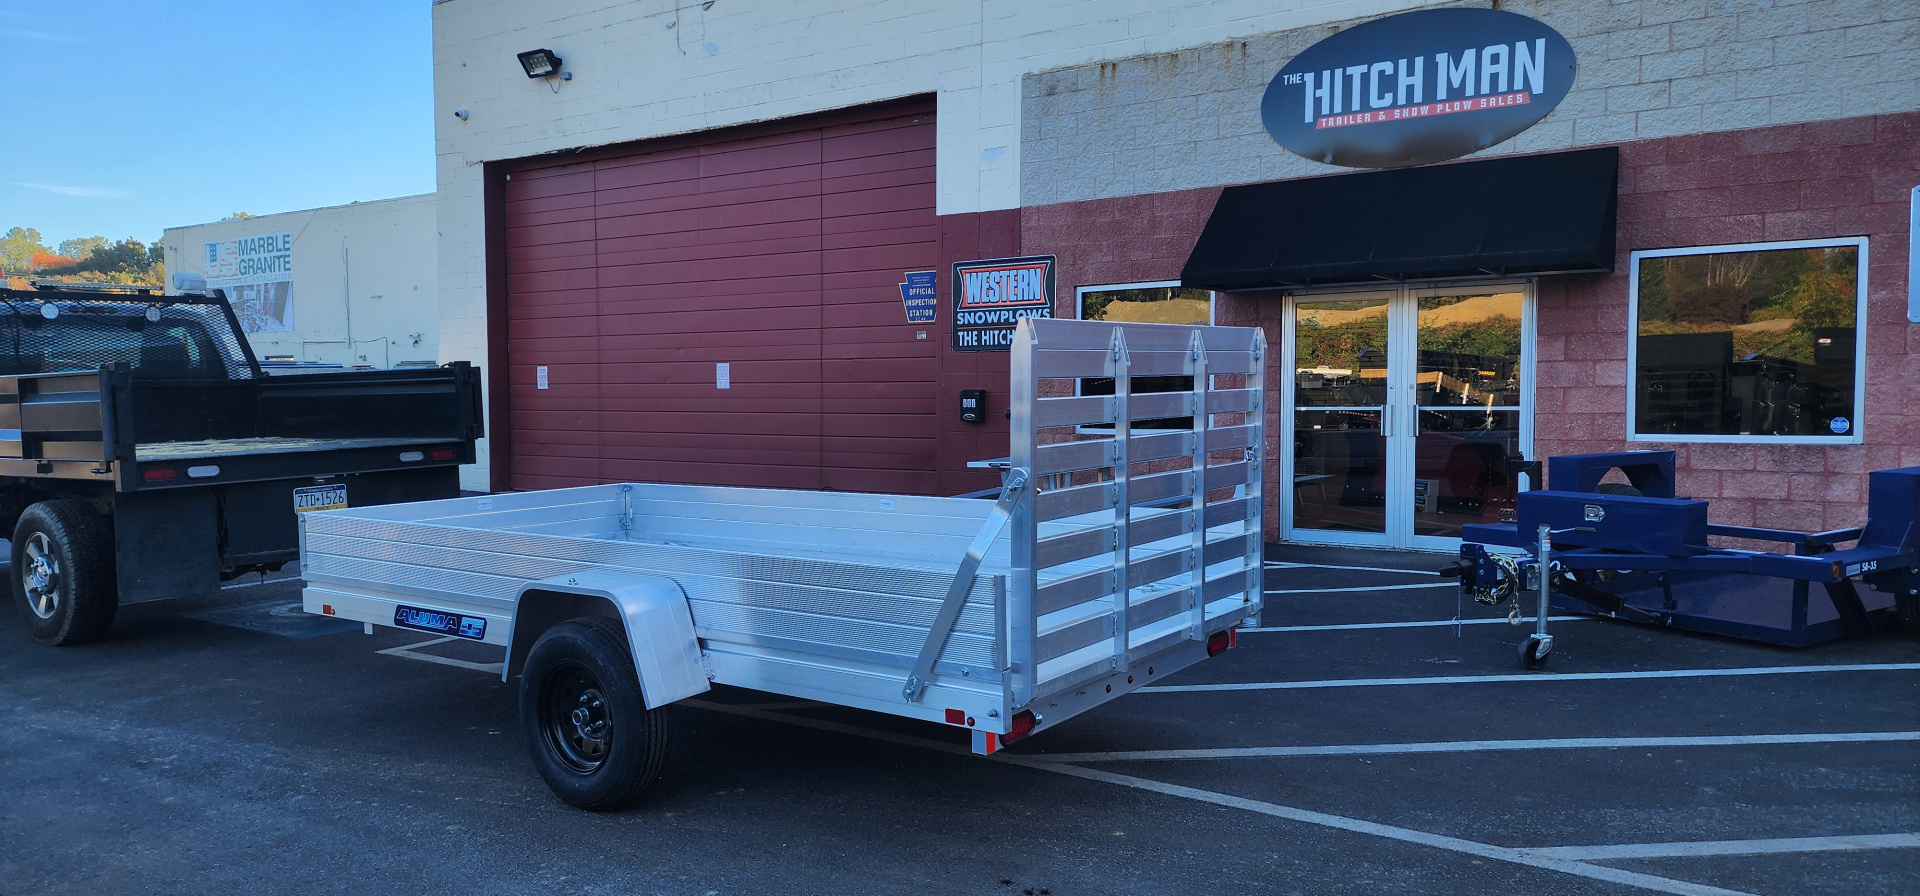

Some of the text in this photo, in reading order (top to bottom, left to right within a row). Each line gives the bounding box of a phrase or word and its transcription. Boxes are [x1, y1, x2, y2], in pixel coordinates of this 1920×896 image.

[1283, 38, 1546, 123] THE HITCH MAN
[1321, 94, 1523, 127] TRAILER & SNOW PLOW SALES
[238, 233, 291, 257] MARBLE
[205, 241, 238, 278] US
[238, 254, 291, 276] GRANITE
[250, 273, 292, 283] INSTALLATION
[965, 268, 1041, 304] WESTERN
[905, 298, 936, 306] INSPECTION
[909, 287, 935, 295] OFFICIAL
[909, 309, 933, 317] STATION
[958, 329, 1016, 346] THE HITCH
[397, 608, 457, 630] ALUMA
